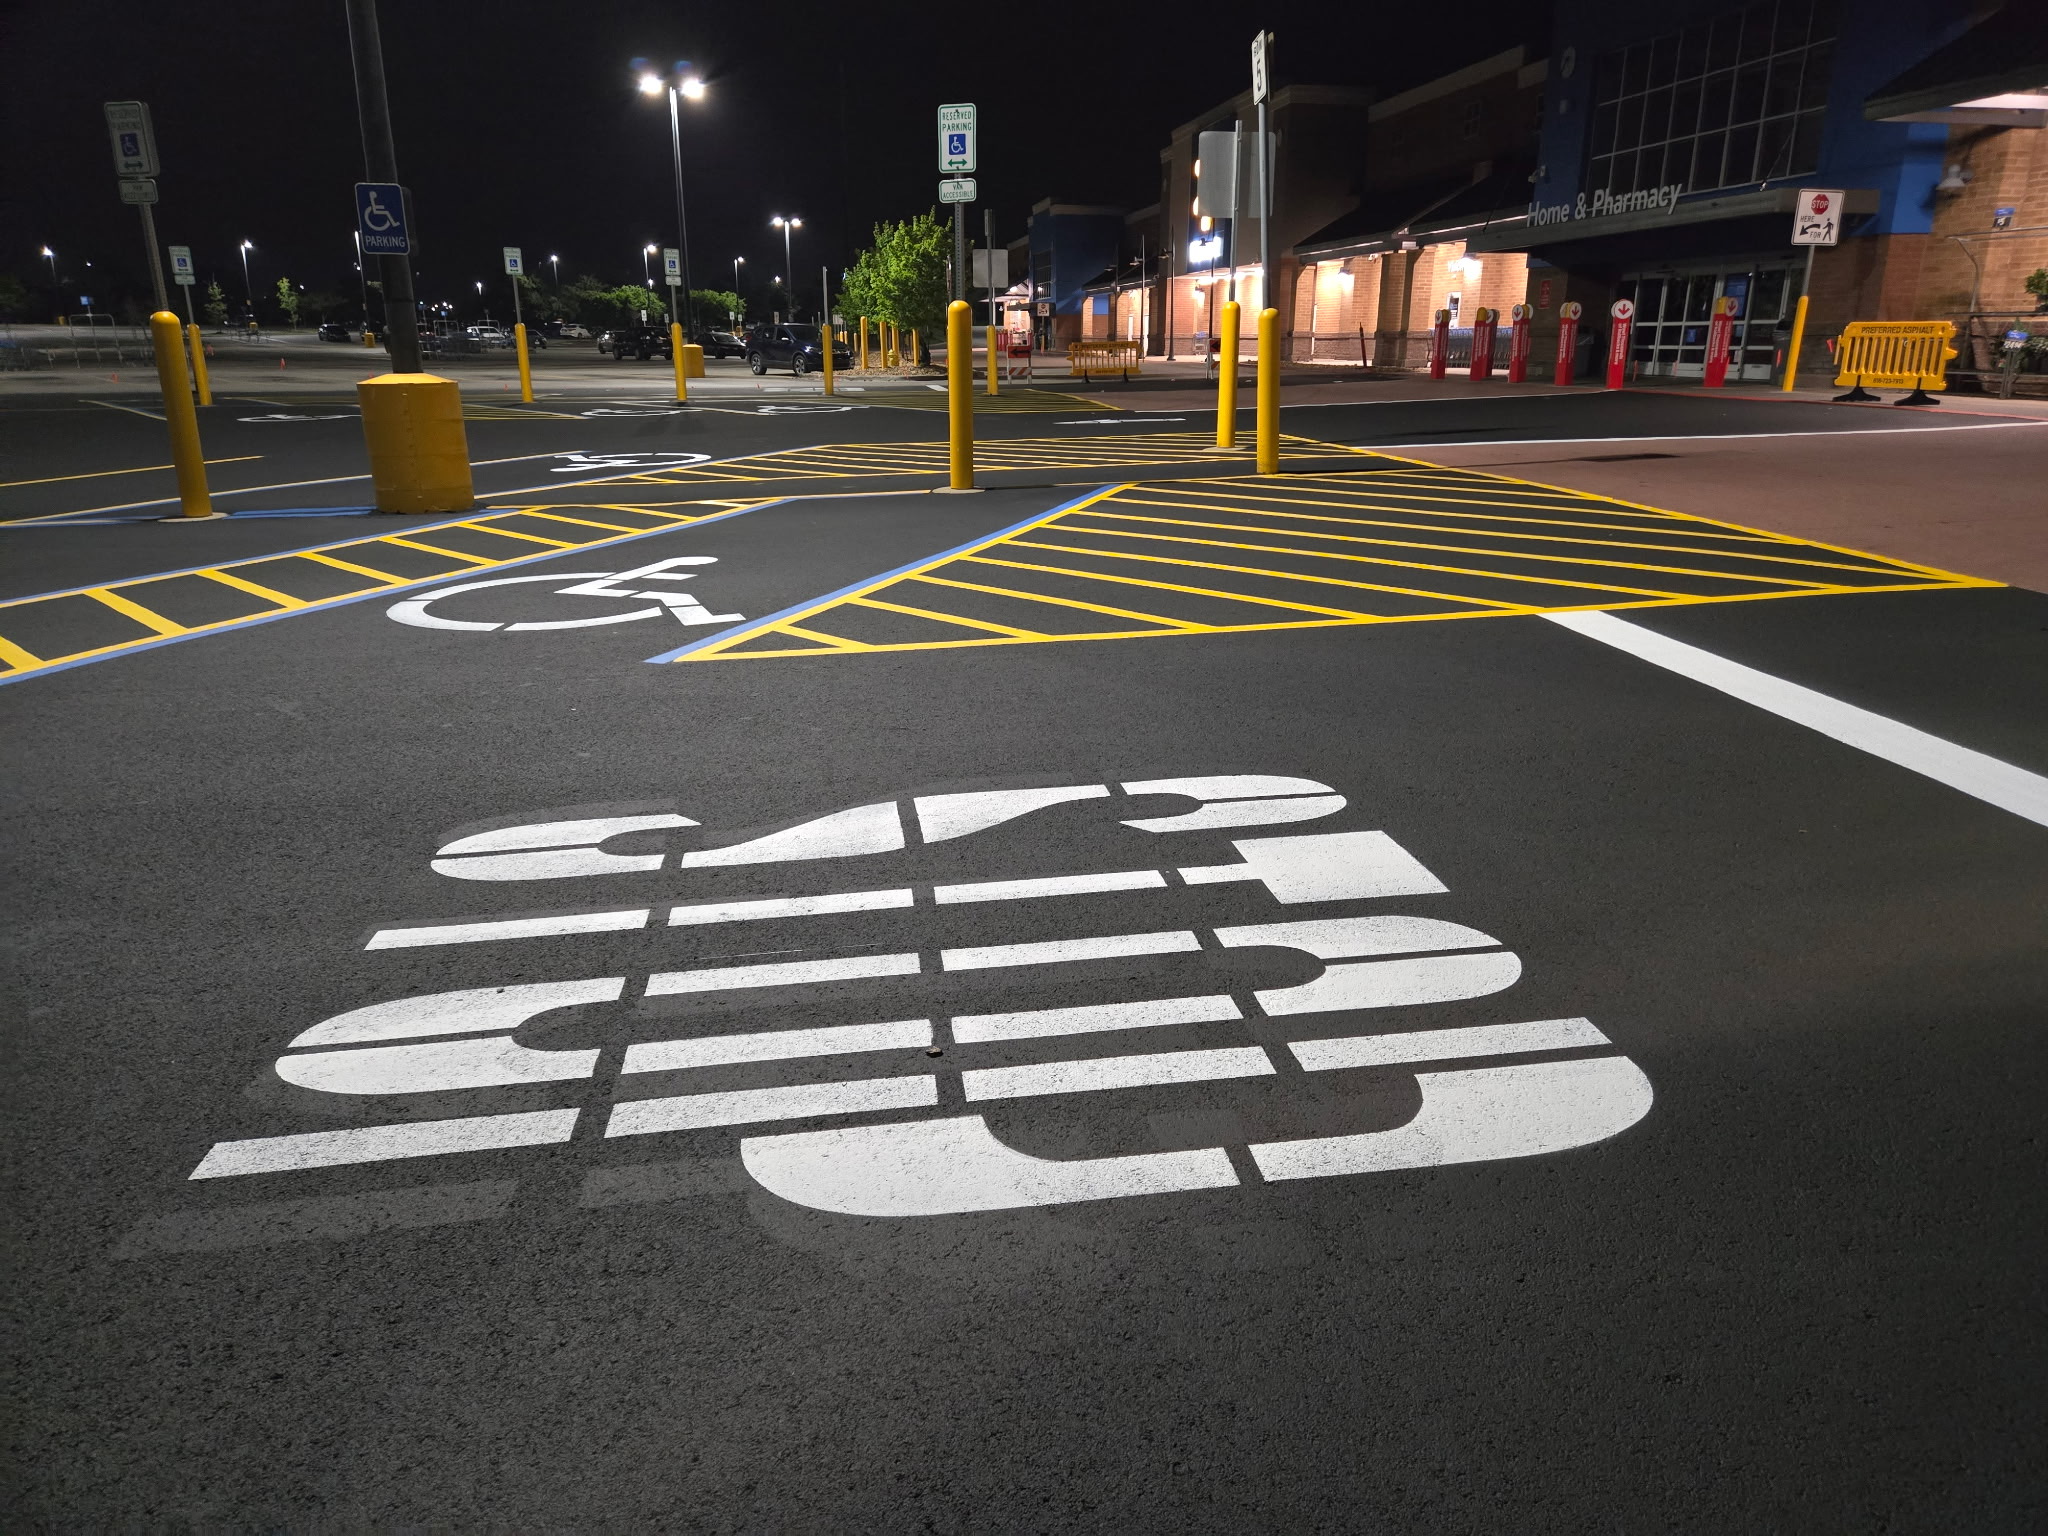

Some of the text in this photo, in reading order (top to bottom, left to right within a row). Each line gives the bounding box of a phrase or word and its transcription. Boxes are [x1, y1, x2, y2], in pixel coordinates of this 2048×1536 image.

[1256, 58, 1263, 92] 5
[942, 110, 972, 121] RESERVED
[942, 122, 972, 132] PARKING
[943, 190, 974, 199] ACCESSIBLE
[1526, 183, 1683, 228] Home & Pharmacy
[1811, 199, 1829, 209] STOP
[1809, 231, 1822, 239] FOR
[365, 235, 406, 248] PARKING
[1861, 326, 1935, 334] PREFERRED ASPHALT
[187, 774, 1656, 1219] STOP
